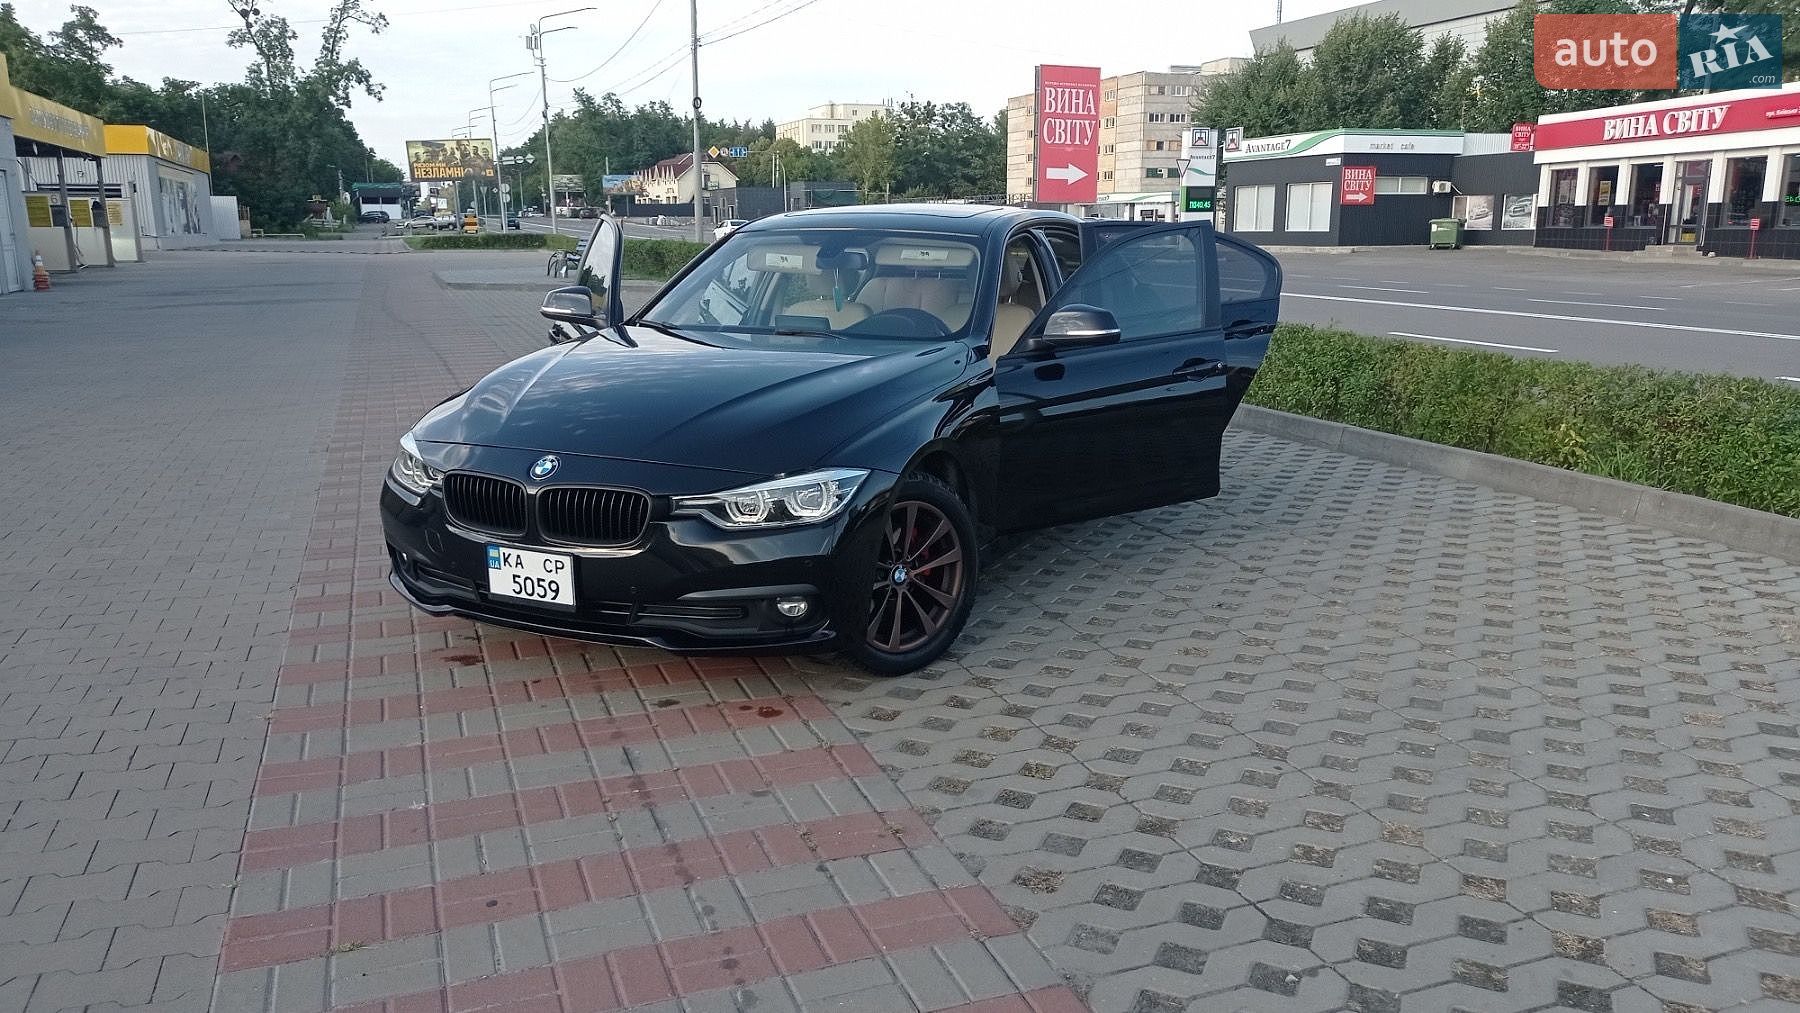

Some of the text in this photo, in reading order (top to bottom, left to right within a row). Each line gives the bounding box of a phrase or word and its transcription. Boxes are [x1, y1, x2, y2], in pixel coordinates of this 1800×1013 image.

[1044, 87, 1097, 115] ВИНА
[1043, 117, 1097, 145] СВІТУ
[1602, 104, 1731, 141] ВИНА СВІТУ
[414, 167, 464, 178] НЕЗЛАМНІ
[1344, 169, 1373, 180] ВИНА
[1343, 180, 1373, 191] СВІТУ
[490, 560, 500, 569] UA
[512, 573, 560, 601] 5059
